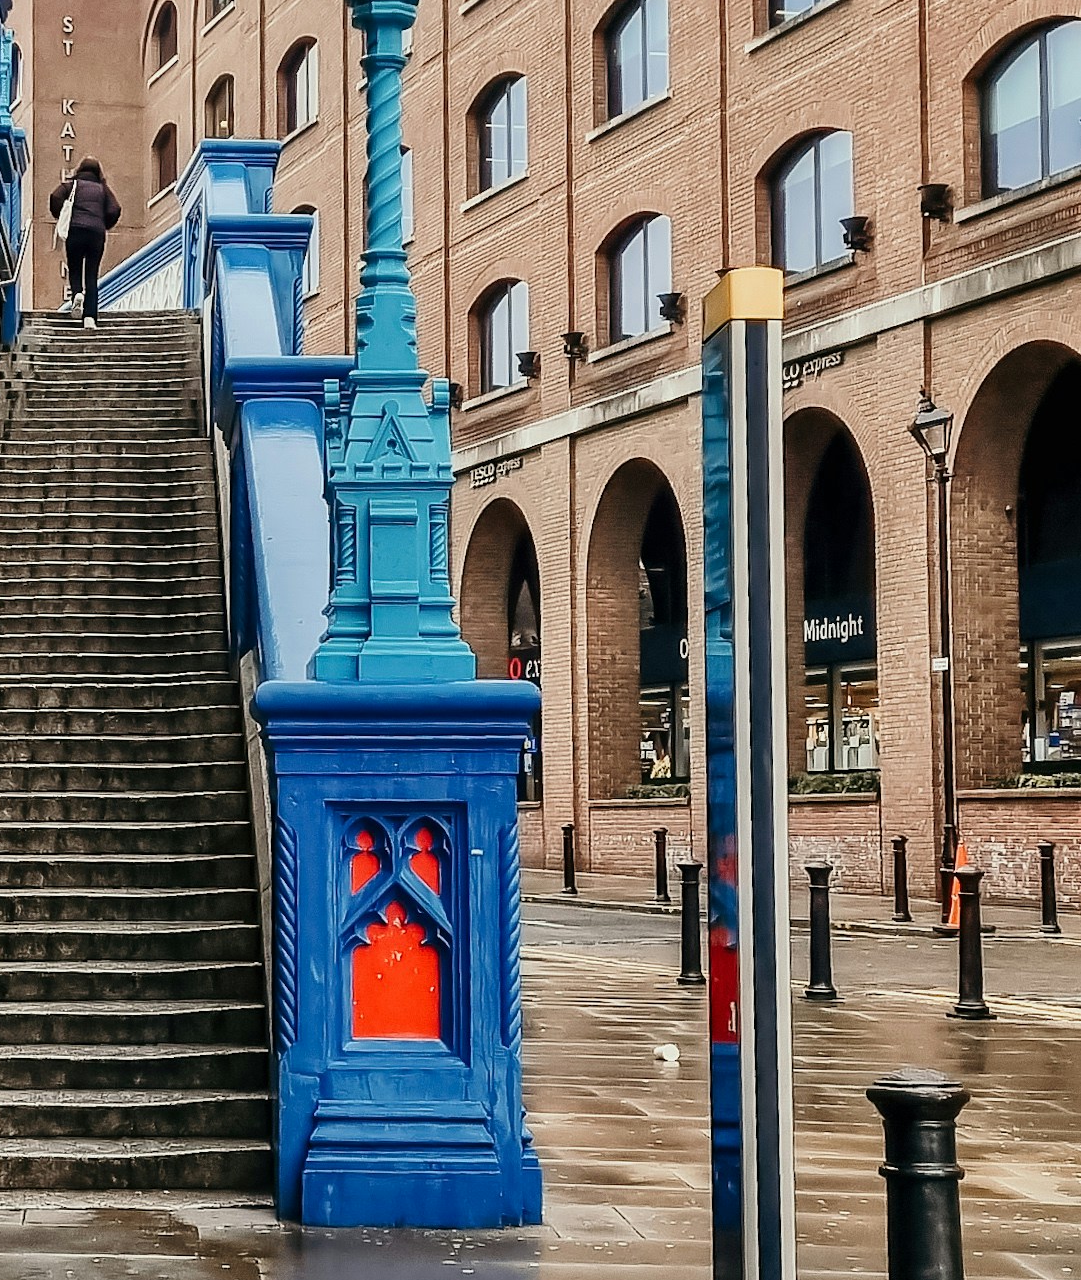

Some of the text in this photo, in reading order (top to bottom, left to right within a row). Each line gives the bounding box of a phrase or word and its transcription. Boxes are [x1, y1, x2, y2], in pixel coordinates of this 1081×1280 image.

[62, 16, 74, 56] ST
[802, 352, 841, 381] express
[469, 463, 495, 482] TESCO
[803, 613, 864, 644] Midnight
